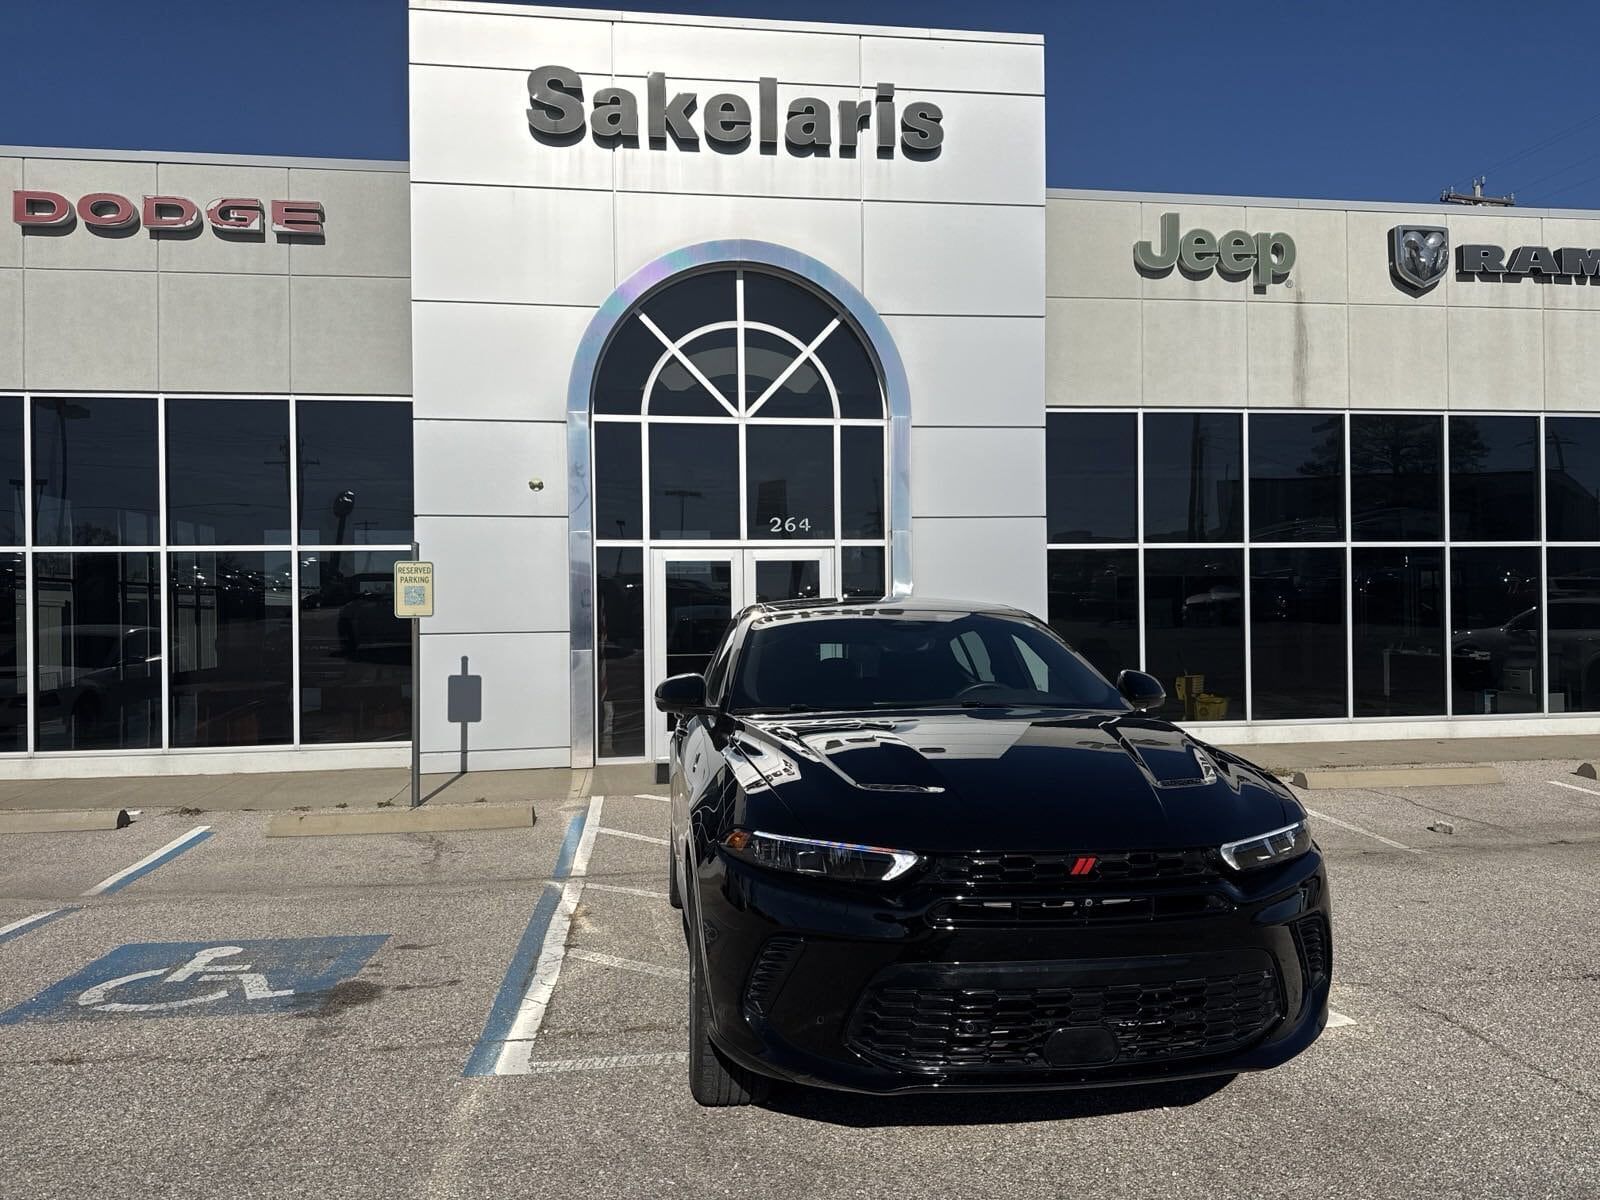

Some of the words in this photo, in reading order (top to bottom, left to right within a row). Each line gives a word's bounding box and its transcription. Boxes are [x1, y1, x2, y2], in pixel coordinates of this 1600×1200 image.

[526, 65, 945, 156] Sakelaris
[13, 190, 326, 238] DODGE
[1133, 212, 1296, 290] Jeep
[1456, 244, 1600, 280] RAM
[769, 517, 811, 532] 264
[398, 566, 431, 574] RESERVED
[400, 576, 430, 584] PARKING
